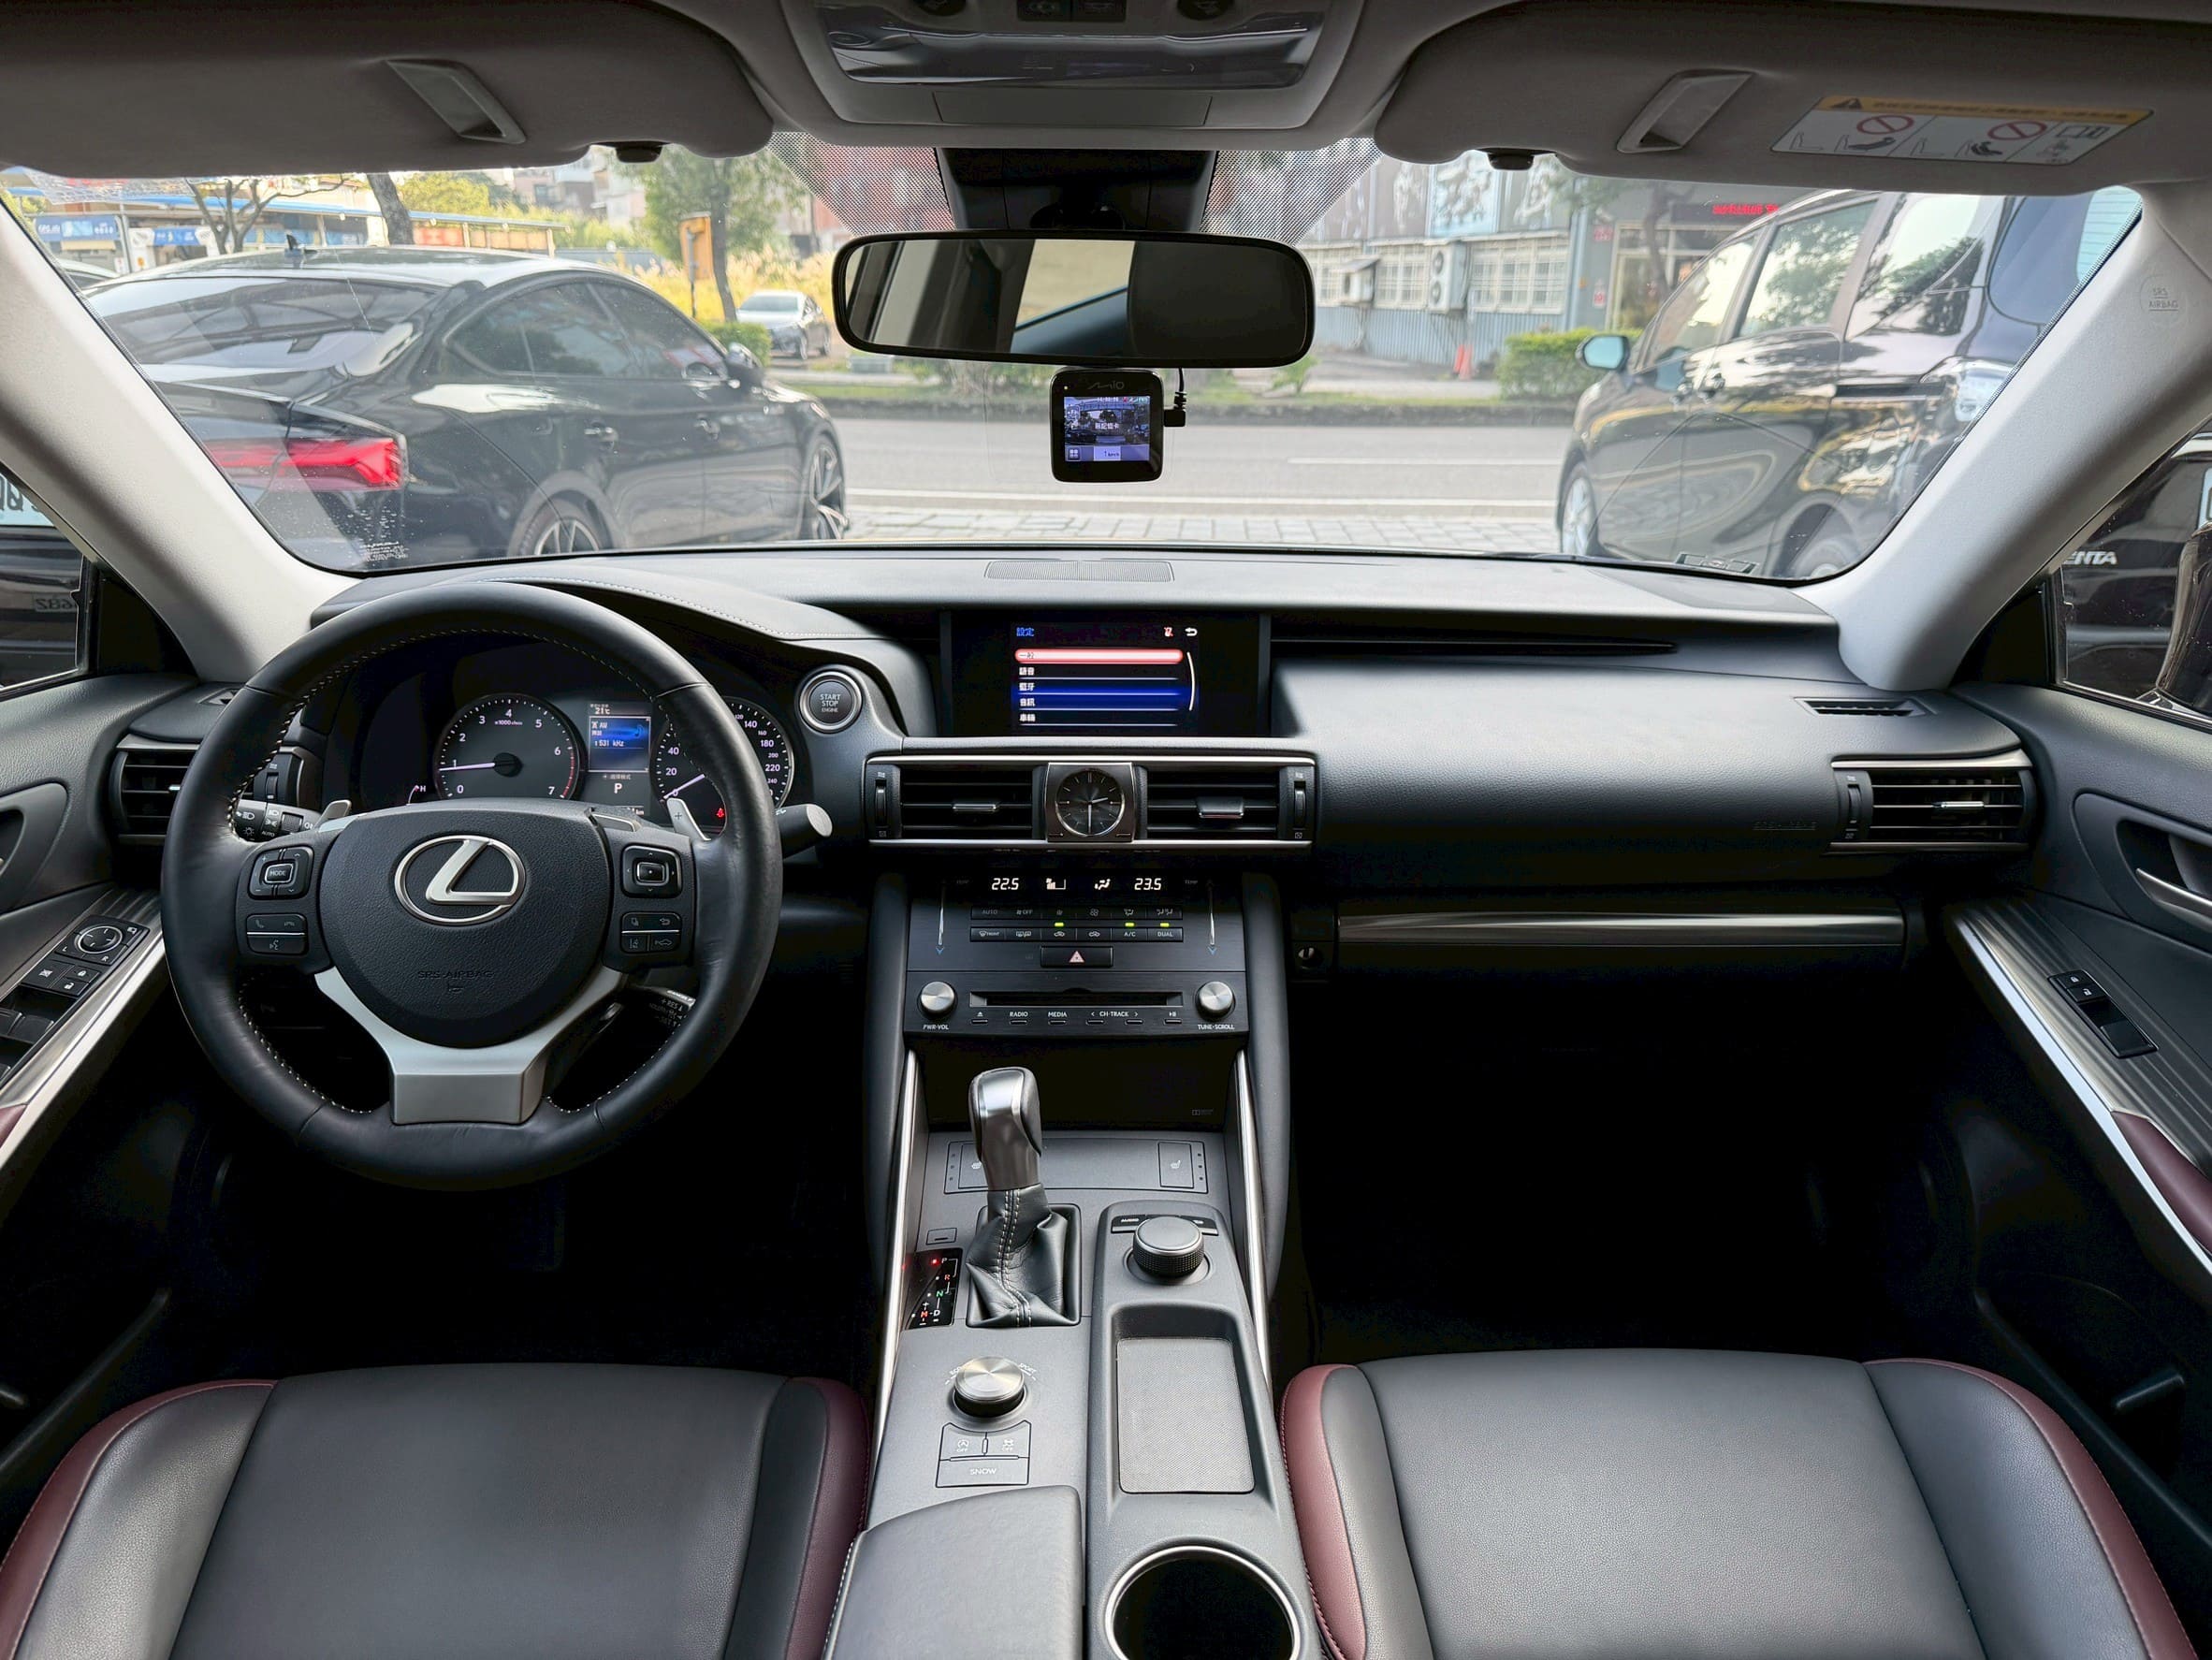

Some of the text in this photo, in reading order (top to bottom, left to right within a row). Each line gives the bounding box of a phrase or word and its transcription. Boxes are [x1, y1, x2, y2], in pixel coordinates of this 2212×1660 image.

[505, 709, 513, 718] 4
[479, 715, 486, 724] 3
[535, 719, 543, 728] 5
[459, 734, 466, 742] 2
[554, 747, 561, 756] 6
[668, 747, 679, 755] 40
[666, 767, 677, 776] 20
[765, 764, 780, 772] 220
[457, 784, 464, 794] 0
[548, 786, 555, 794] 7
[614, 782, 622, 794] P
[992, 878, 1020, 890] 22.5
[1134, 878, 1162, 890] 23.5
